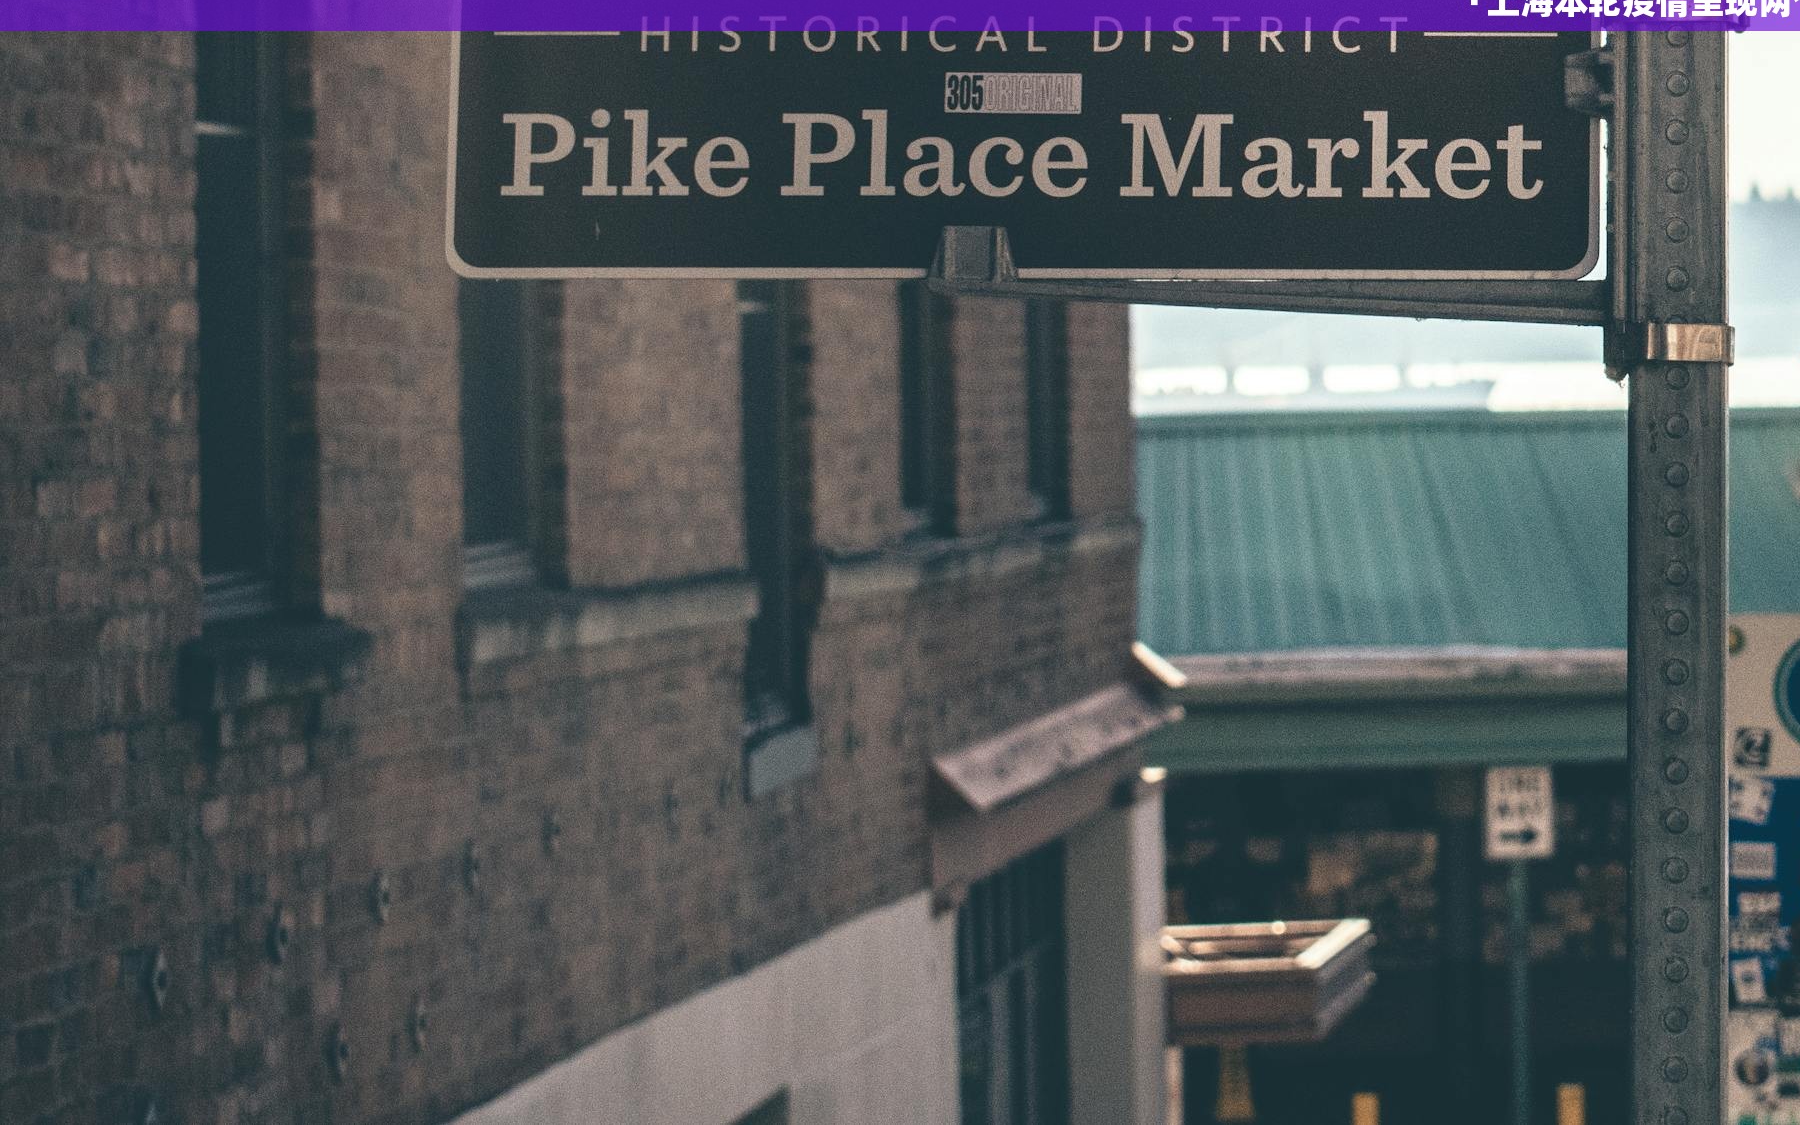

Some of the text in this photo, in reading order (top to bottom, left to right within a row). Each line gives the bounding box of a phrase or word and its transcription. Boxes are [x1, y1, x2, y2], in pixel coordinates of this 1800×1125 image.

[640, 15, 1407, 53] HISTORICAL DISTRICT
[500, 108, 1544, 200] Pike Place Market
